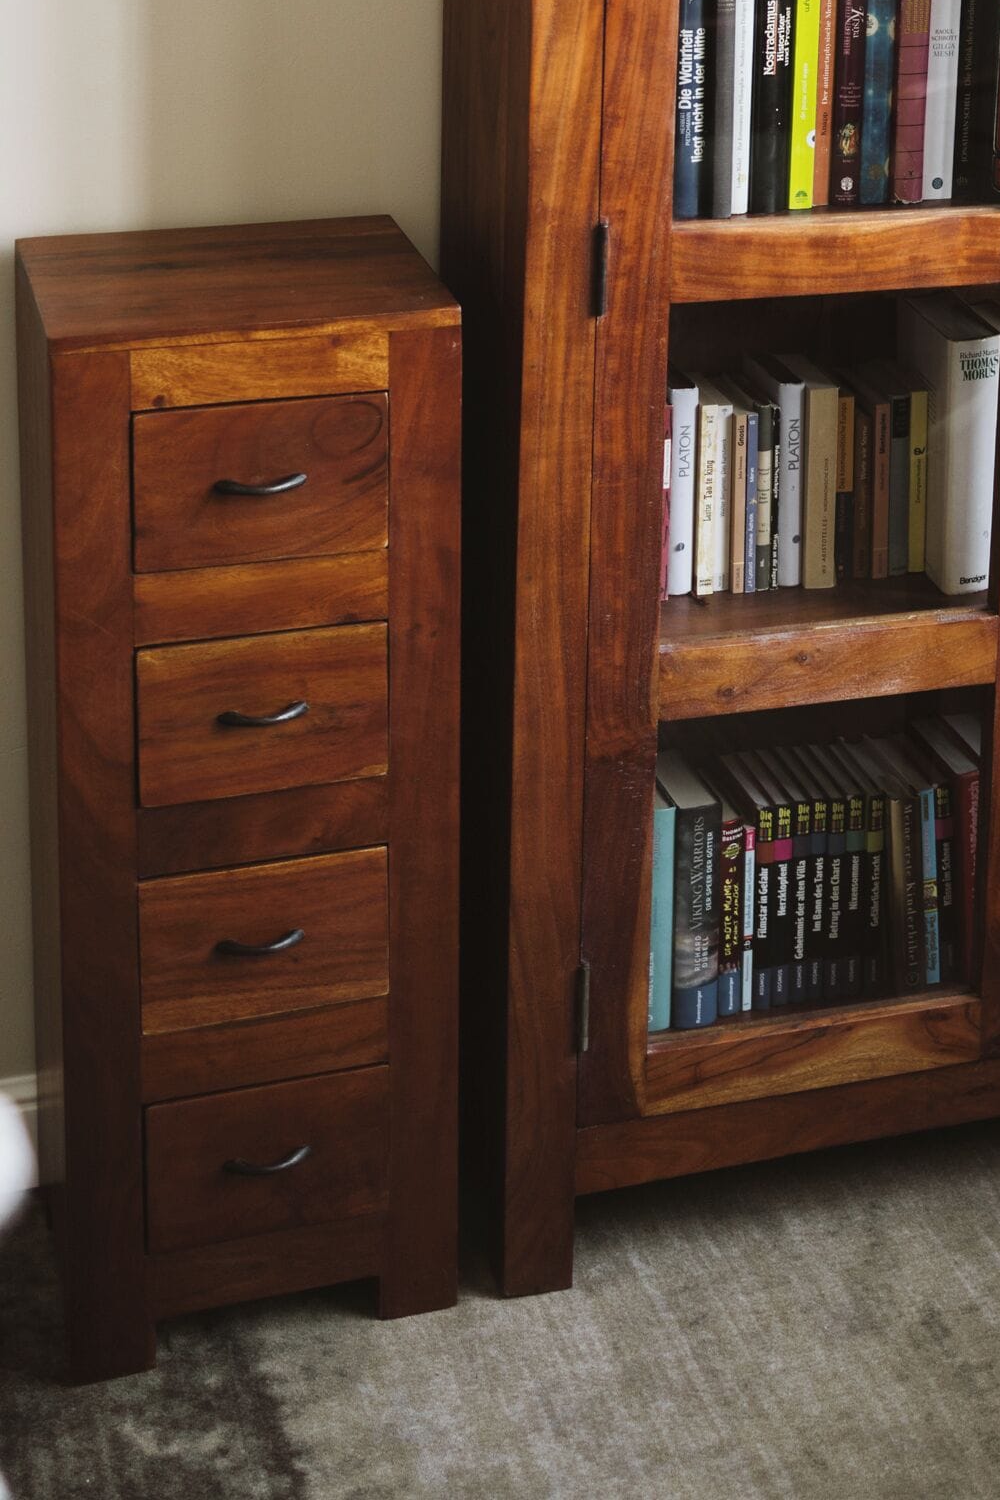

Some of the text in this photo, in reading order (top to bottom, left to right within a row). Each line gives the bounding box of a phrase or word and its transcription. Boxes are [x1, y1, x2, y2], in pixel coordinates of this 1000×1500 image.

[763, 0, 777, 75] Nostradamus
[776, 13, 786, 62] Historiker
[822, 20, 833, 89] antimetaphysische
[933, 50, 954, 58] MESH
[678, 29, 694, 109] Die Wahrheit
[691, 28, 706, 163] liegt nicht in der Mitte
[821, 90, 830, 105] Der
[820, 112, 829, 136] Knapp
[960, 351, 982, 360] Richard
[960, 355, 999, 371] THOMAS
[962, 367, 996, 382] MORUS
[679, 425, 691, 478] PLATON
[738, 425, 746, 446] Gnosis
[788, 418, 801, 471] PLATON
[704, 460, 716, 500] Tao te king
[959, 574, 987, 585] Benziger
[760, 810, 772, 821] Die
[778, 807, 791, 818] Die
[689, 816, 705, 931] VIKING WARRIORS
[704, 831, 715, 910] DER SPEER DER GÖTTER
[758, 867, 769, 895] Gefahr
[777, 864, 788, 916] Herzklopfen!
[812, 857, 824, 932] Im Bann des Tarots
[848, 855, 859, 910] Nixensommer
[870, 855, 881, 928] Gefährliche Fracht
[757, 905, 768, 939] Filmstar
[795, 860, 807, 960] Geheimnis der alten Villa
[829, 858, 841, 939] Betrug in den Charts
[694, 935, 702, 972] RICHARD
